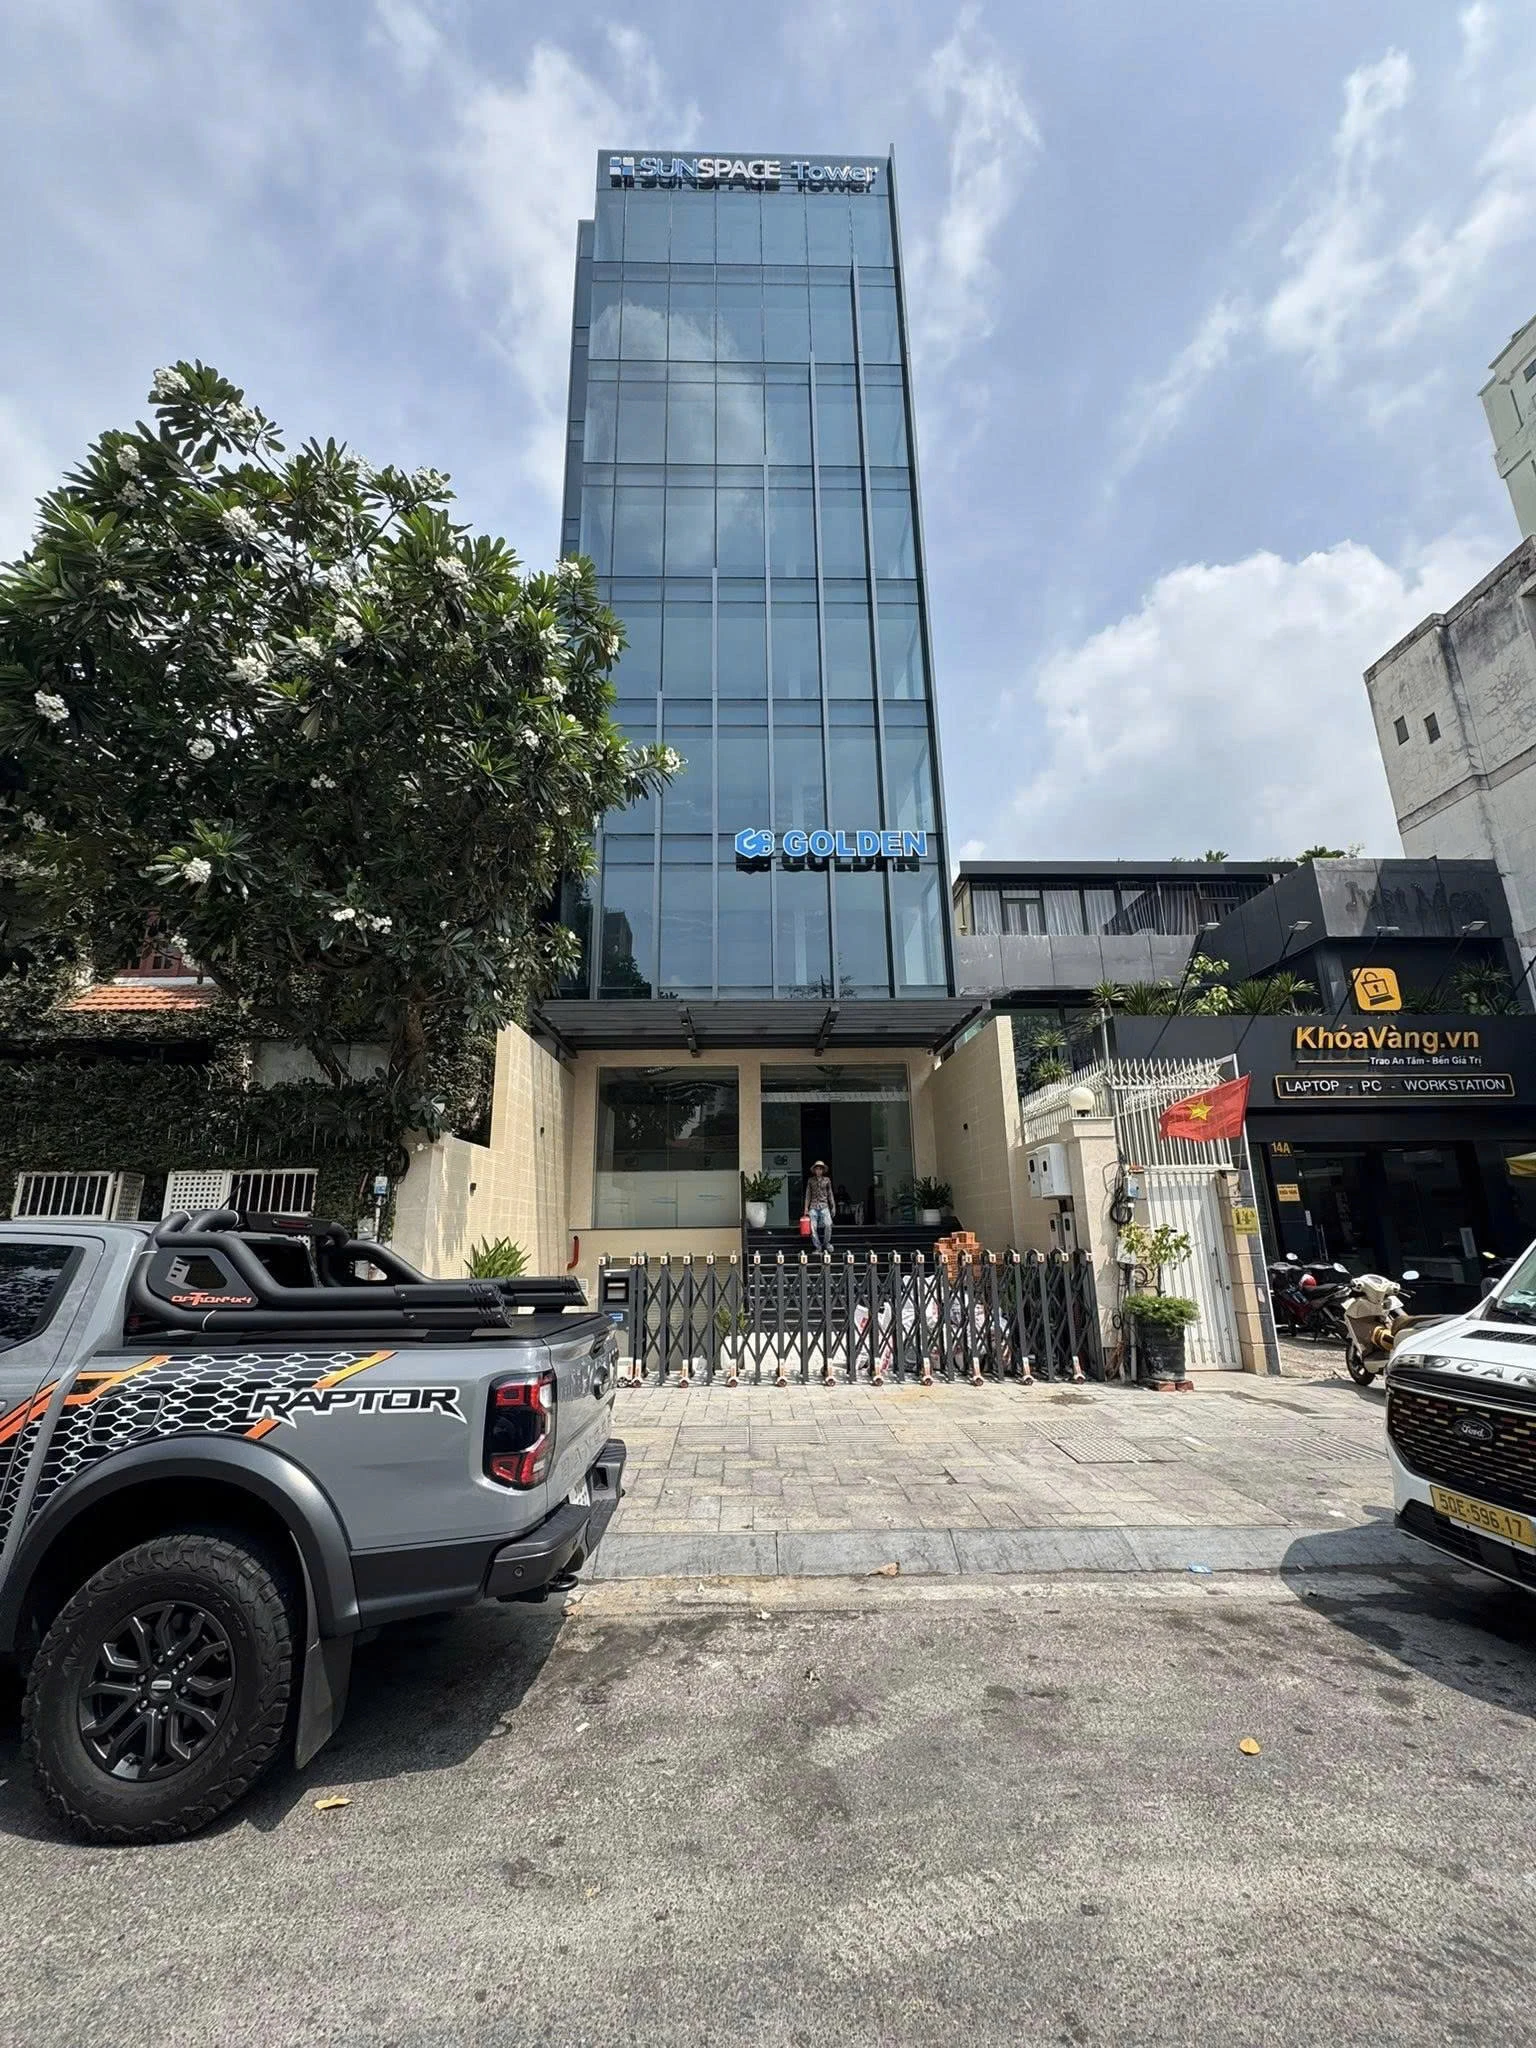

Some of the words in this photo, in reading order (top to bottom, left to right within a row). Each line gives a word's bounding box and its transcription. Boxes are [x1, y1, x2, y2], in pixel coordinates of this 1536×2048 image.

[639, 157, 781, 179] SUNSPACE
[791, 161, 879, 182] Tower
[782, 829, 928, 857] GOLDEN
[1296, 1025, 1480, 1054] KhóaVàng.vn
[1370, 1057, 1390, 1065] Trao
[1392, 1057, 1404, 1065] An
[1285, 1080, 1340, 1092] LAPTOP
[1361, 1080, 1382, 1092] PC
[1404, 1078, 1506, 1091] WORKSTATION
[247, 1387, 468, 1429] RAPTOR
